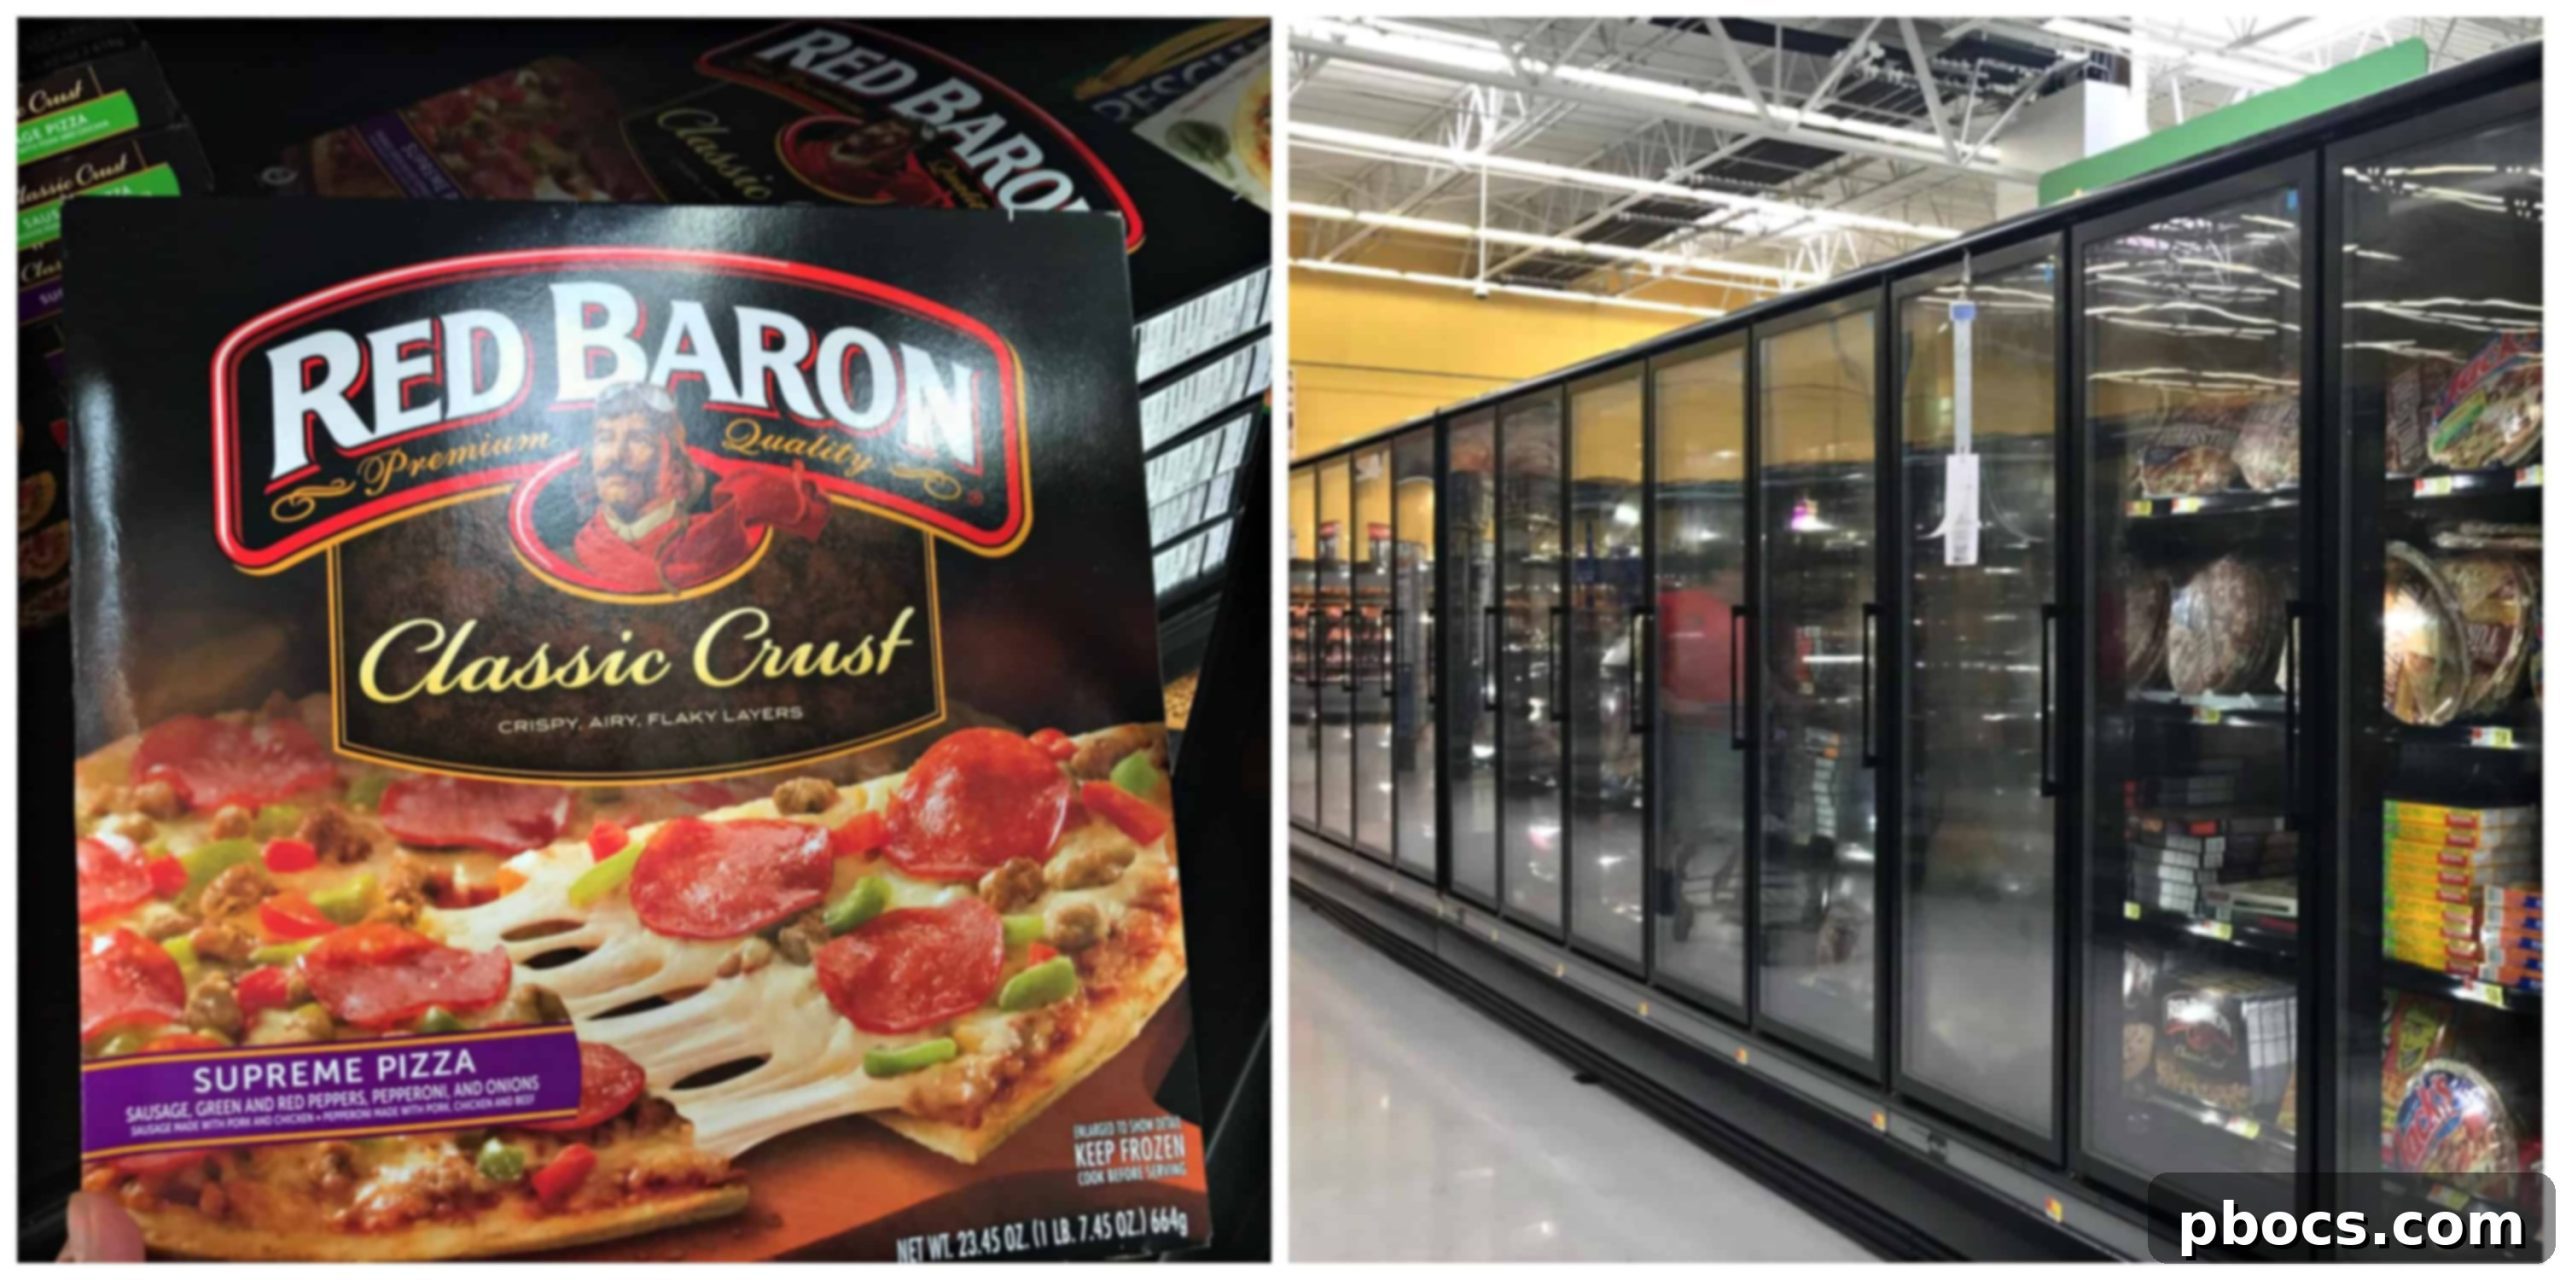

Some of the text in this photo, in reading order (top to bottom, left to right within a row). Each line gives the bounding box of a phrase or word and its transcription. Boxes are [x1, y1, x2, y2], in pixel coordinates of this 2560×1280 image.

[754, 28, 917, 96] RED
[889, 77, 1093, 213] BARO
[656, 107, 773, 200] Classic
[265, 308, 527, 482] RED
[548, 280, 975, 466] BARON
[357, 430, 551, 497] Premium
[720, 416, 875, 477] Quality
[358, 605, 916, 703] Classic Crust
[497, 704, 804, 735] CRISPY, AIRY, FLAKY LAYERS
[125, 1074, 540, 1124] SAUSAGE, GREEN AND RED PEPPERS, PEPPERONI, AND ONIONS
[193, 1047, 477, 1095] SUPREME PIZZA
[201, 1118, 226, 1131] WITH
[1074, 1133, 1186, 1169] KEEP FROZEN
[1146, 1159, 1187, 1180] SERVING
[896, 1204, 1188, 1264] NET WT. 23.45 OZ. (1 LB. 7.45 OZ.) 664g
